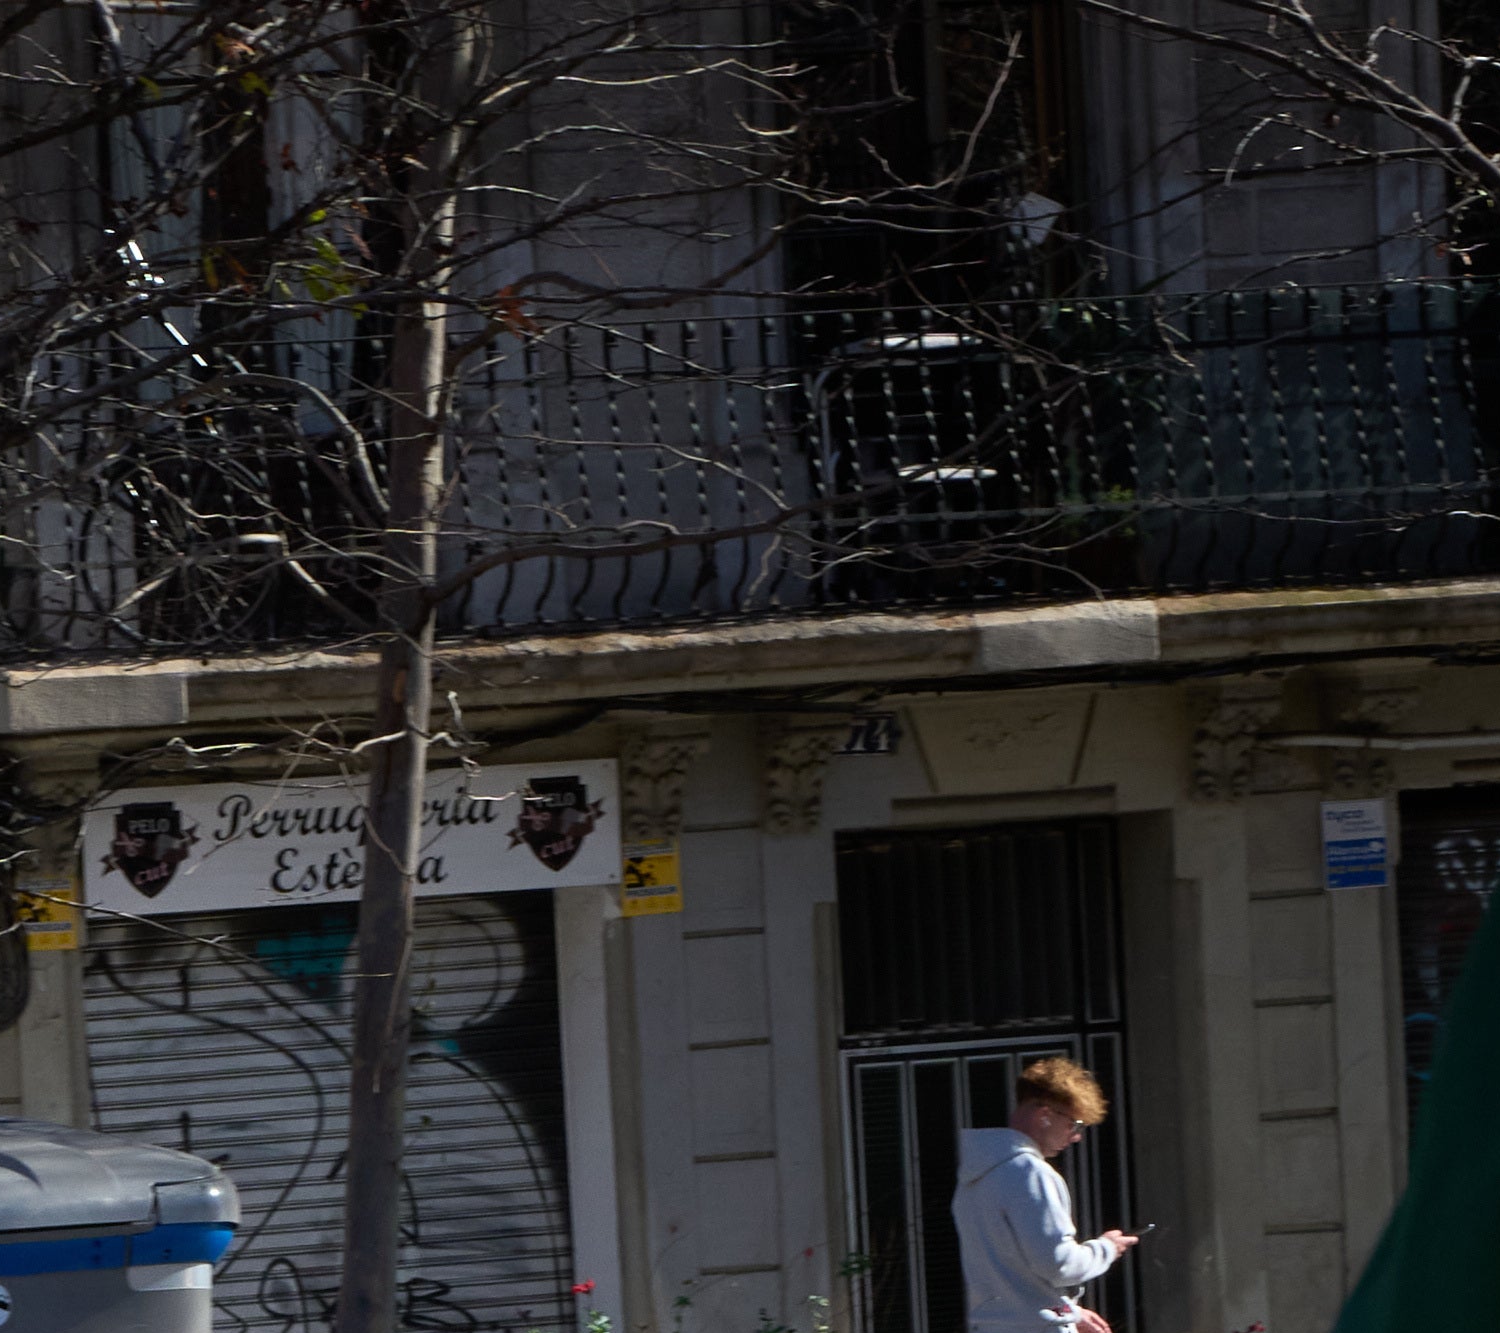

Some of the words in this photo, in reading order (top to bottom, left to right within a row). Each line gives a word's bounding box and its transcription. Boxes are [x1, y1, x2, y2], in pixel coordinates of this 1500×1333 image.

[128, 818, 170, 833] PELO
[215, 786, 497, 847] Perruqria
[134, 862, 169, 885] cut
[271, 846, 449, 894] Estèa
